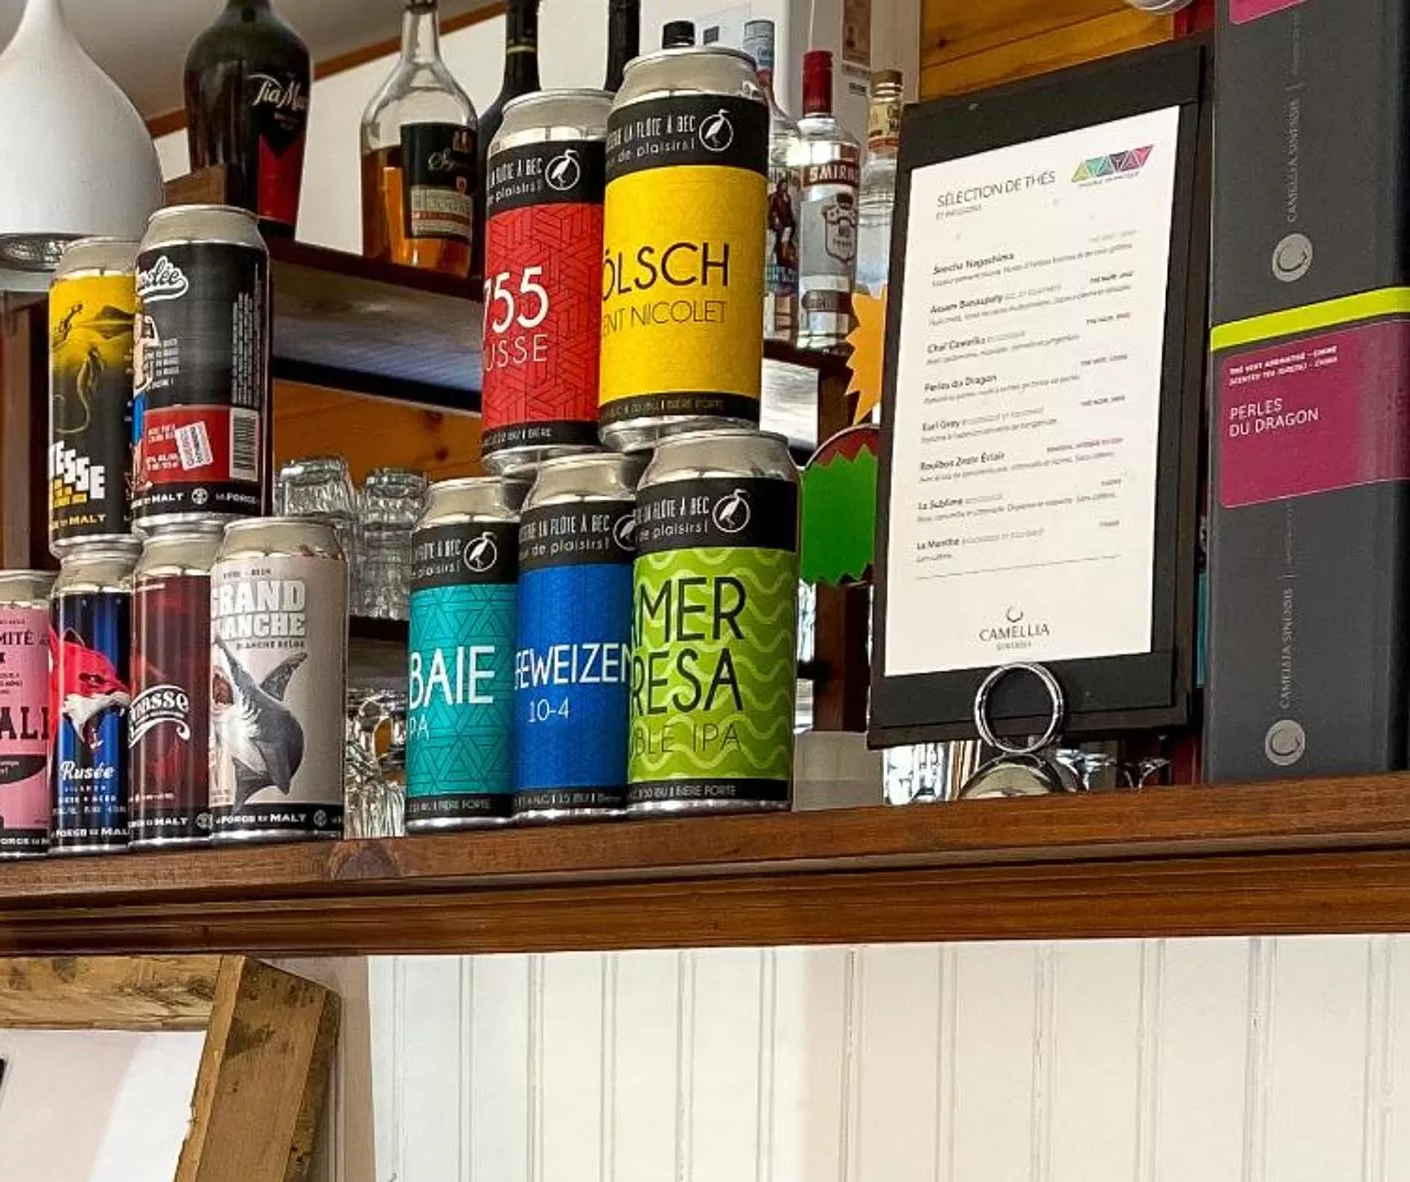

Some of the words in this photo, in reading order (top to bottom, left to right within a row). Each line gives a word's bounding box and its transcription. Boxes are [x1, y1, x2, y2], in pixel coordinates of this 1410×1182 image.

[677, 115, 696, 133] BEC
[631, 299, 726, 327] NICOLET
[1230, 398, 1283, 420] PERLES
[1229, 421, 1250, 437] DU
[1255, 407, 1319, 433] DRAGON
[69, 514, 106, 525] MALT
[591, 514, 611, 533] BEC
[639, 577, 747, 644] MER
[979, 624, 1050, 641] CAMELLIA
[409, 645, 496, 710] BAIE
[529, 697, 570, 723] 10-4
[693, 723, 742, 754] IPA
[59, 760, 116, 781] Rusée
[154, 816, 189, 827] MALT
[270, 813, 307, 823] MALT
